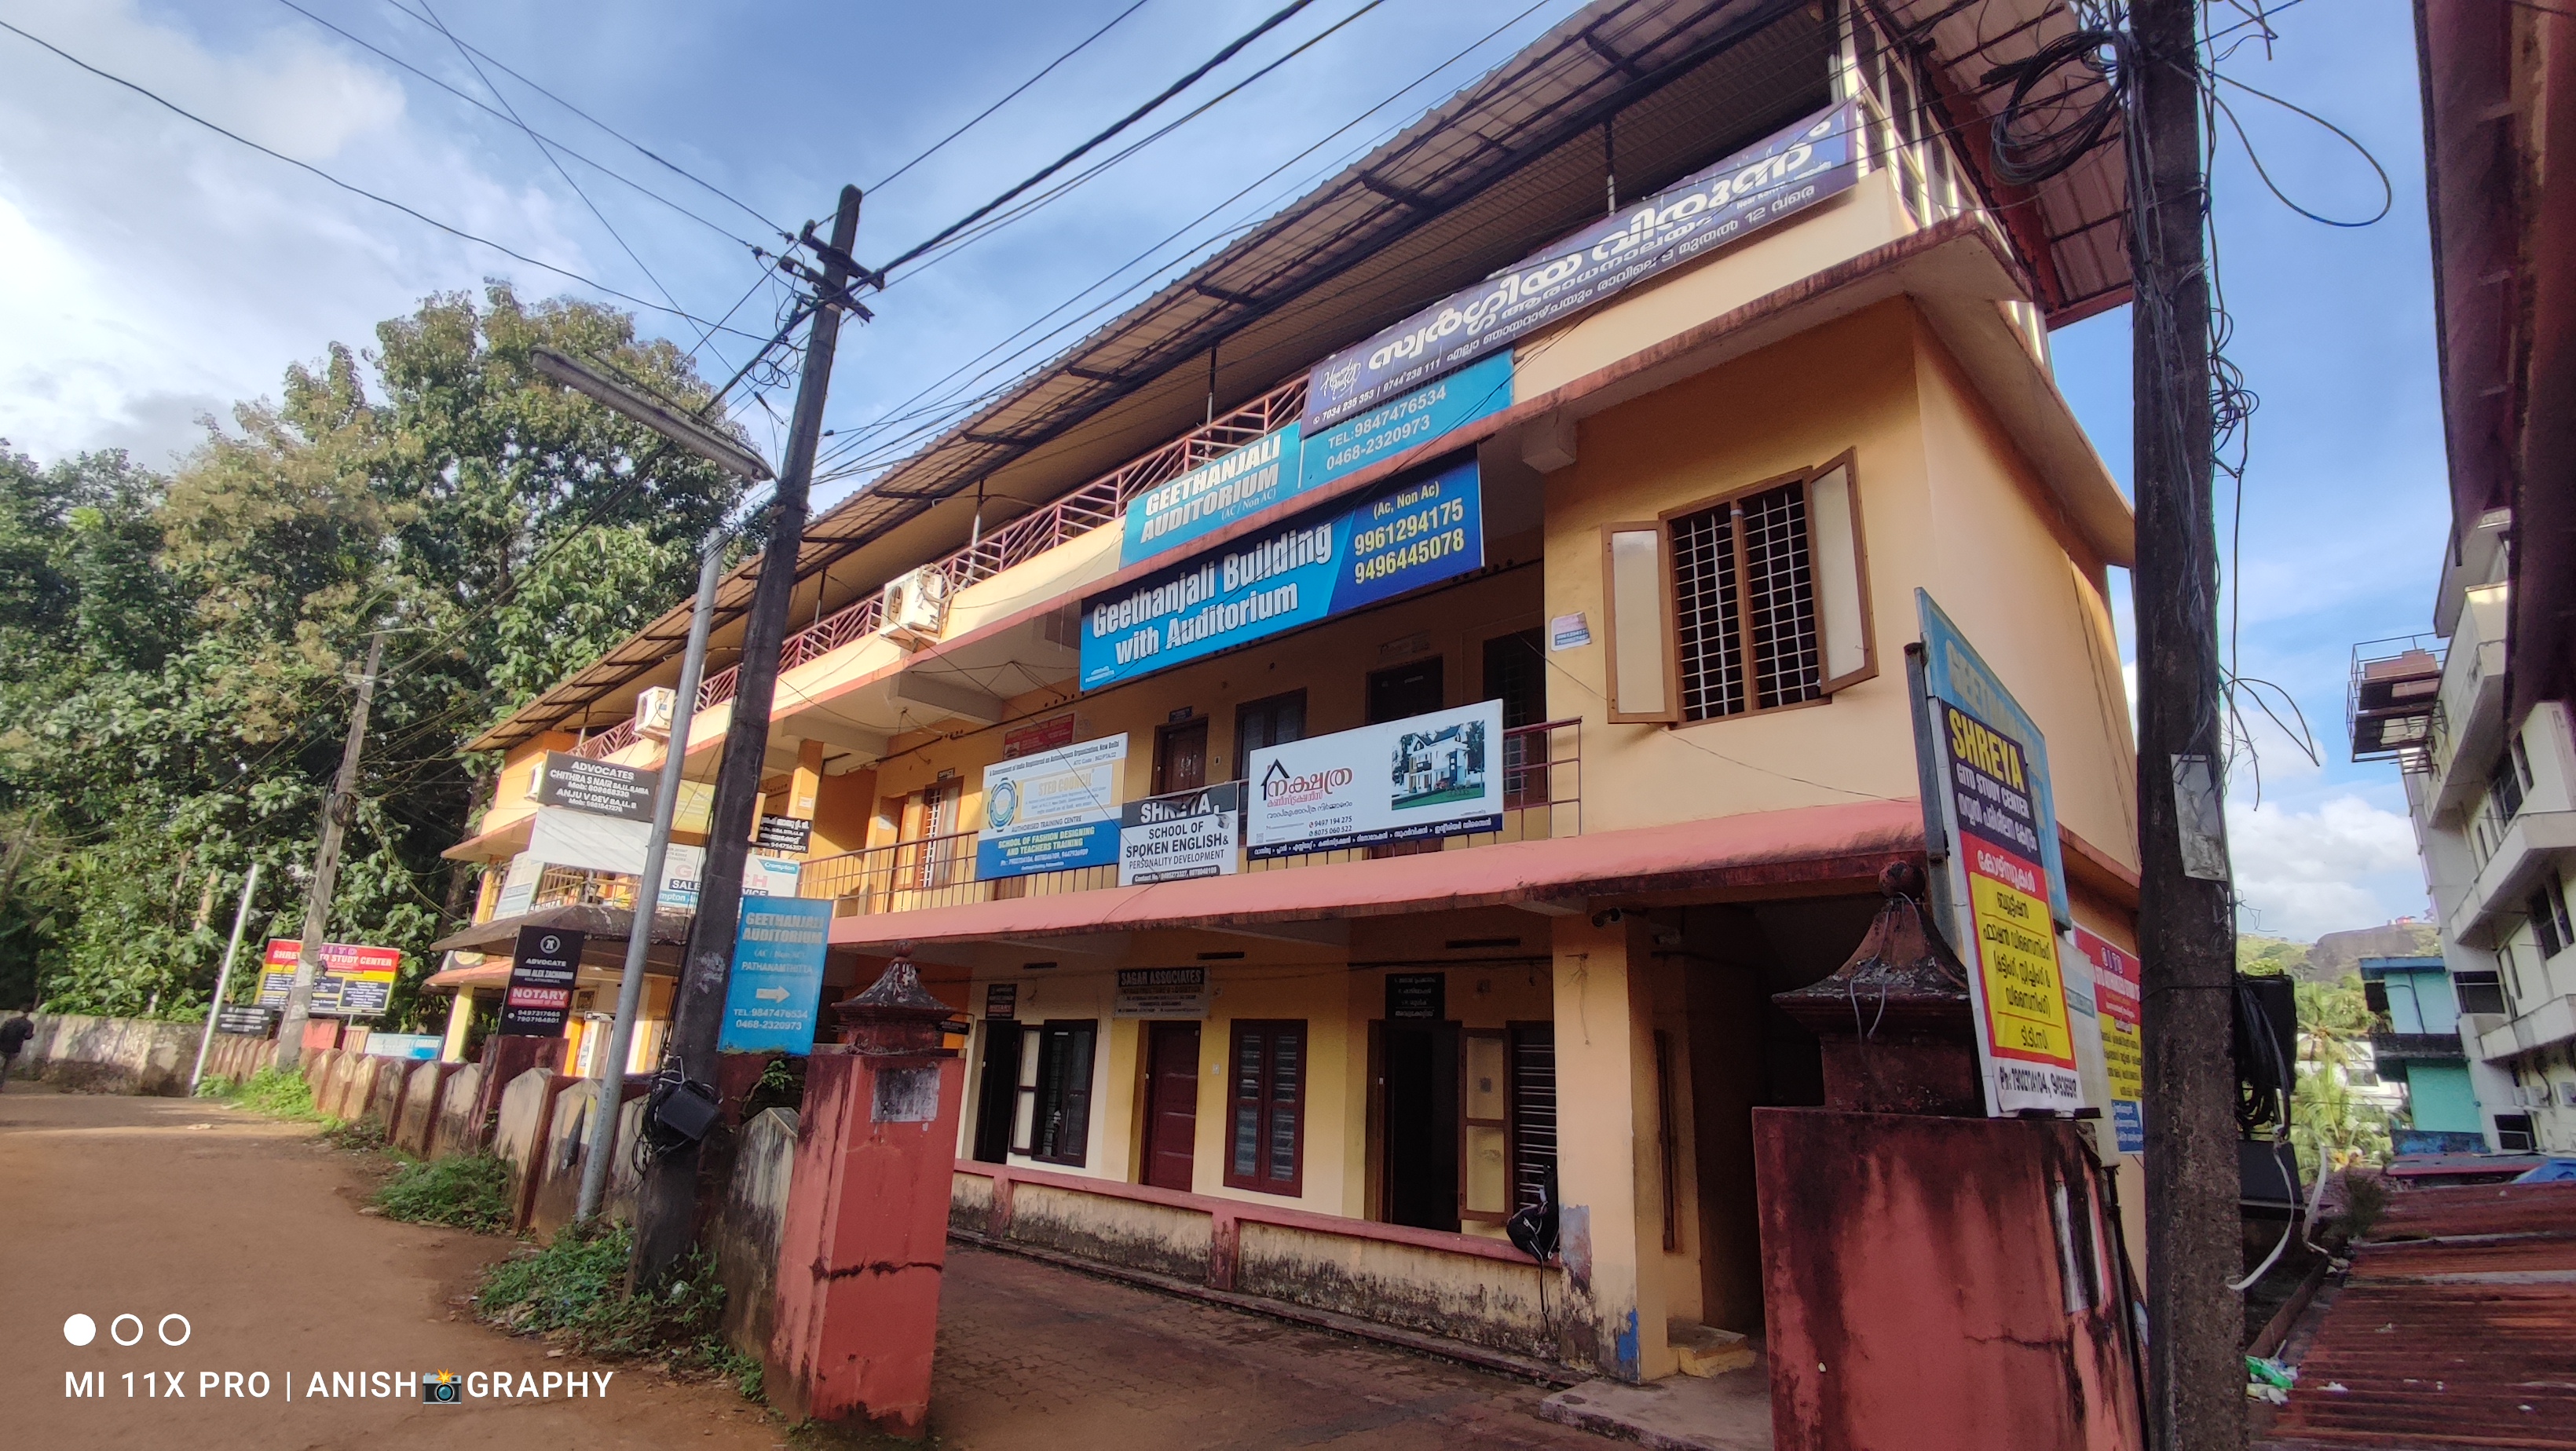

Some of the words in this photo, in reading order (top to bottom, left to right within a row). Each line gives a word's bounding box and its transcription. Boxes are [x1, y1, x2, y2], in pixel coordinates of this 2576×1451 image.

[1745, 207, 1766, 225] 12
[1326, 415, 1430, 470] 0468-2320973
[1145, 434, 1281, 516] GEETHANJALI
[1140, 462, 1279, 544] AUDITORIUM
[1243, 497, 1259, 509] Non
[1374, 502, 1394, 520] (Ac,
[1396, 491, 1418, 510] Non
[1421, 481, 1440, 500] Ac)
[1354, 497, 1464, 556] 9961294175
[1355, 528, 1465, 584] 9496445078
[1092, 561, 1216, 638] Geethanjali
[1222, 522, 1333, 593] Building
[1115, 626, 1159, 666] with
[1165, 583, 1297, 650] Auditorium
[1948, 708, 2025, 794] SHREYA
[550, 769, 586, 784] CHITHRA
[587, 776, 593, 784] S
[593, 777, 613, 788] NAIR
[572, 761, 635, 780] ADVOCATES
[556, 788, 582, 799] ANJU
[591, 794, 609, 803] DEV
[1976, 773, 2001, 804] STUDY
[2001, 787, 2030, 819] CENTER
[1149, 824, 1187, 839] SCHOOL
[1191, 821, 1204, 833] OF
[1126, 840, 1169, 858] SPOKEN
[764, 861, 796, 872] Crompton
[1129, 857, 1173, 870] PERSONALITY
[1173, 849, 1224, 864] DEVELOPMENT
[745, 912, 824, 930] GEETHANJALI
[742, 927, 823, 944] AUDITORIUM
[331, 954, 359, 963] STUDY
[360, 956, 392, 967] CENTER
[525, 958, 566, 967] ADVOCATE
[741, 961, 814, 974] PATHANAMTHITTA
[1150, 970, 1201, 985] ASSOCIATES
[512, 988, 567, 1000] NOTARY
[736, 1019, 802, 1031] 0468-2320973
